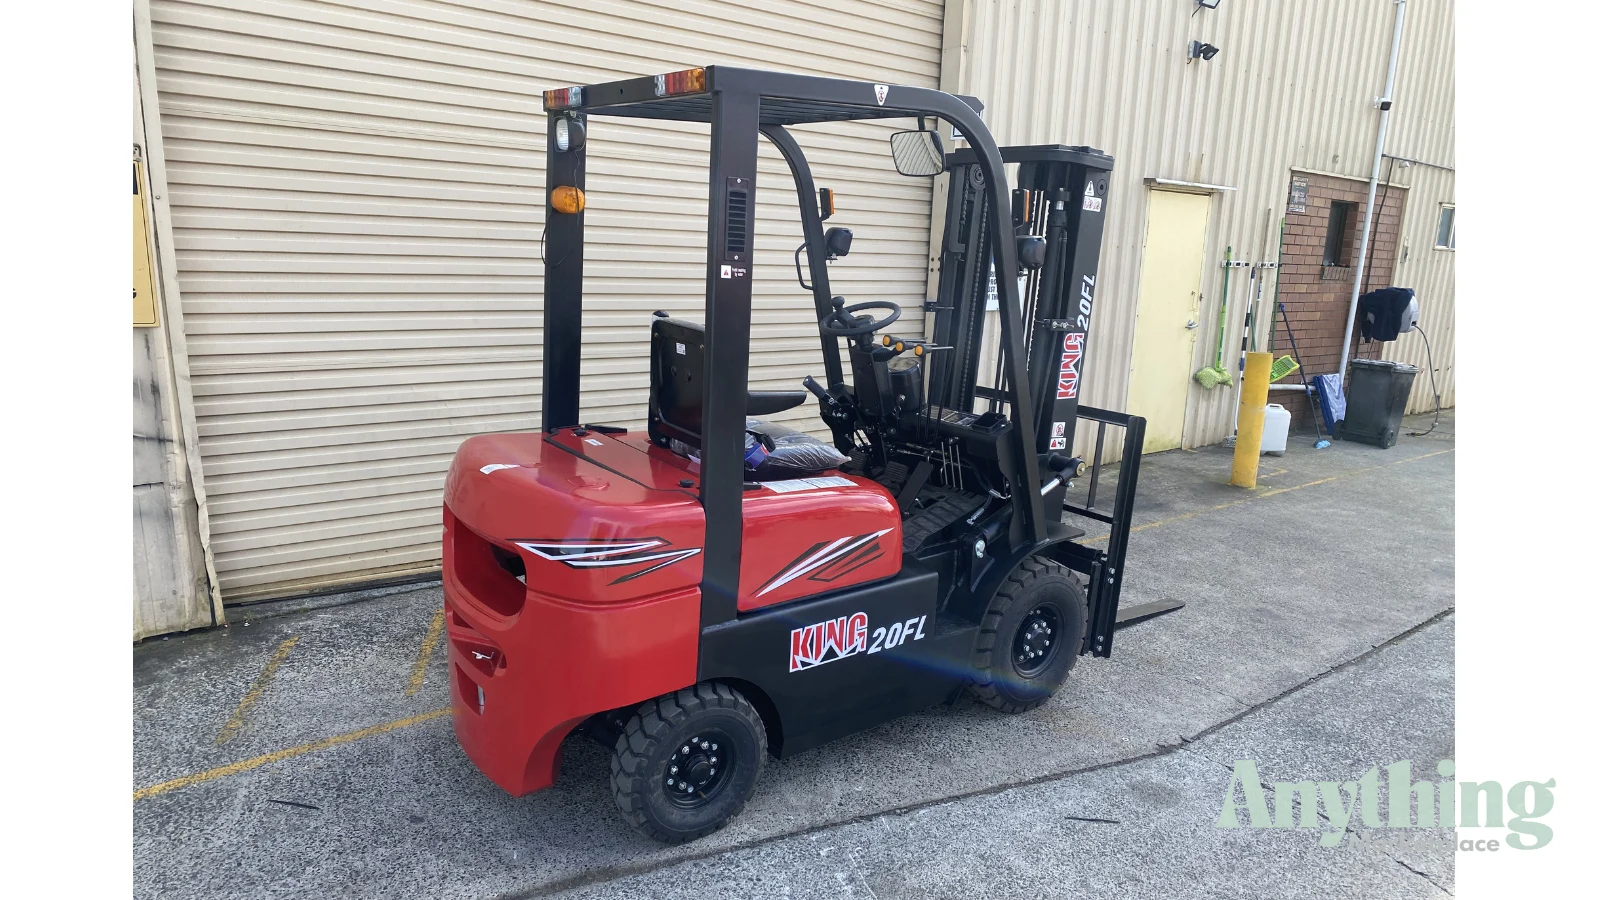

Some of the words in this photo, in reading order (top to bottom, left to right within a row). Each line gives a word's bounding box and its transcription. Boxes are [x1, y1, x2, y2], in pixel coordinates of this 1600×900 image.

[1056, 332, 1085, 400] KING
[1077, 274, 1096, 331] 20FL
[789, 611, 869, 673] KING
[867, 615, 927, 655] 20FL
